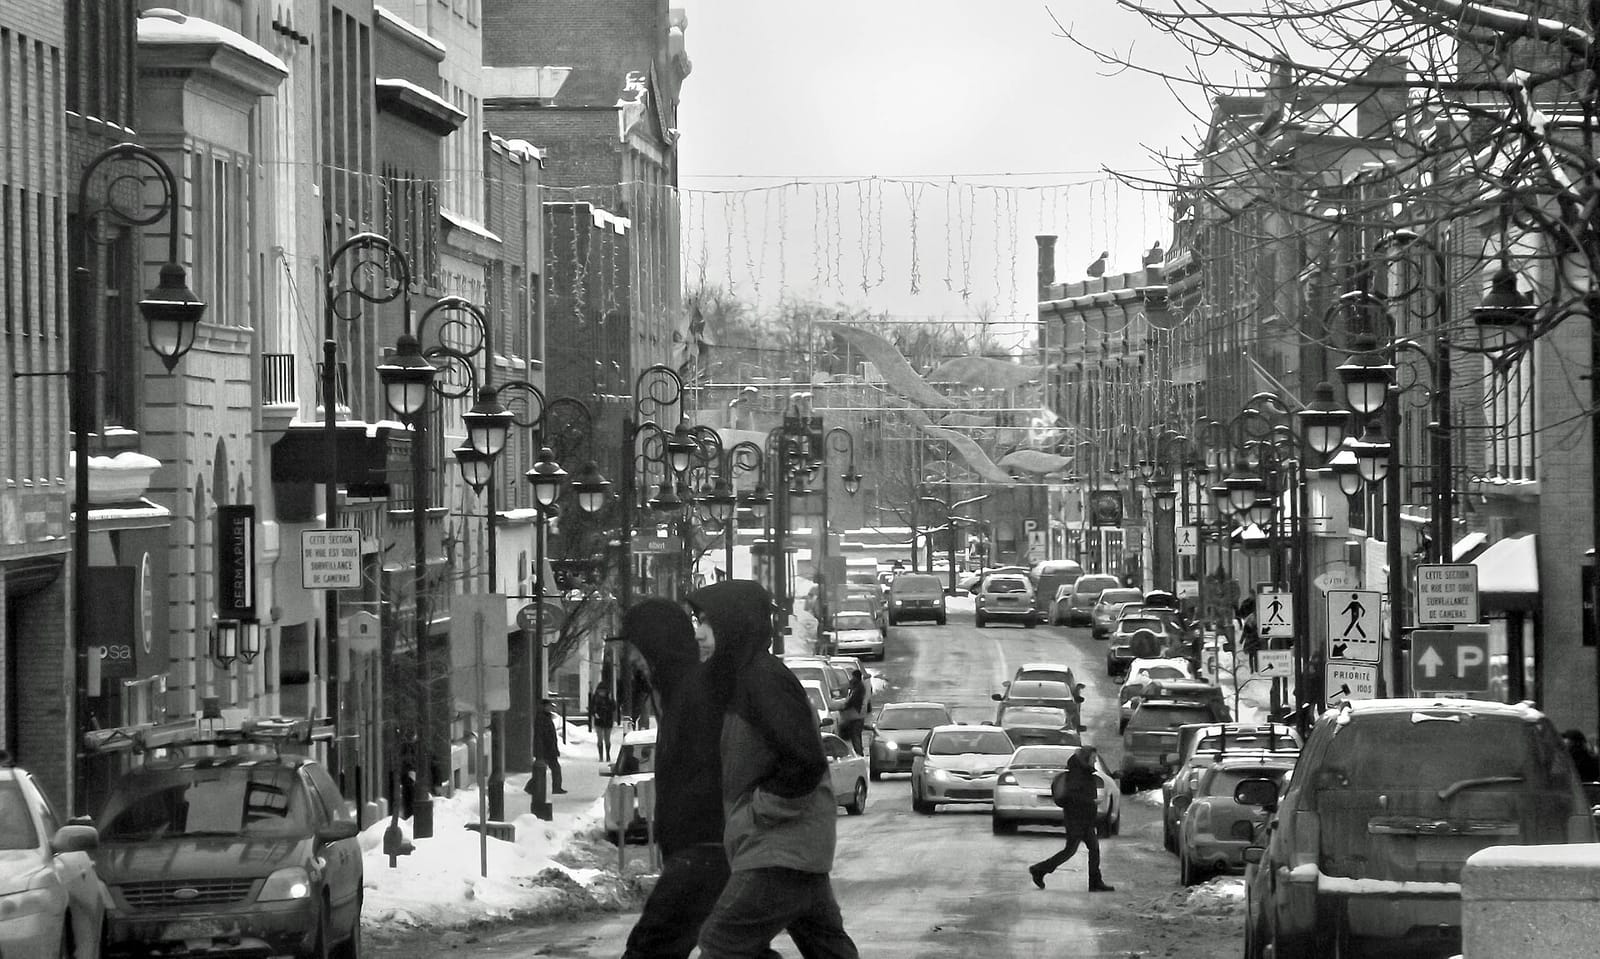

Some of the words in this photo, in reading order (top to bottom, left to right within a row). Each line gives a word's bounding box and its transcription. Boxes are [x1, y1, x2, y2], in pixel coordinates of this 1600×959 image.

[309, 535, 326, 545] CETTE
[328, 535, 353, 545] SECTION
[305, 548, 312, 558] DE
[328, 548, 340, 558] EST
[341, 548, 358, 557] SOUS
[233, 517, 245, 609] DERMAPURE
[311, 561, 353, 570] SURVEILLANCE
[313, 574, 321, 583] DE
[1425, 570, 1443, 580] CETTE
[1444, 570, 1469, 580] SECTION
[1445, 583, 1456, 593] EST
[1426, 596, 1469, 606] SURVEILLANCE
[1429, 609, 1437, 619] DE
[1456, 645, 1484, 678] P
